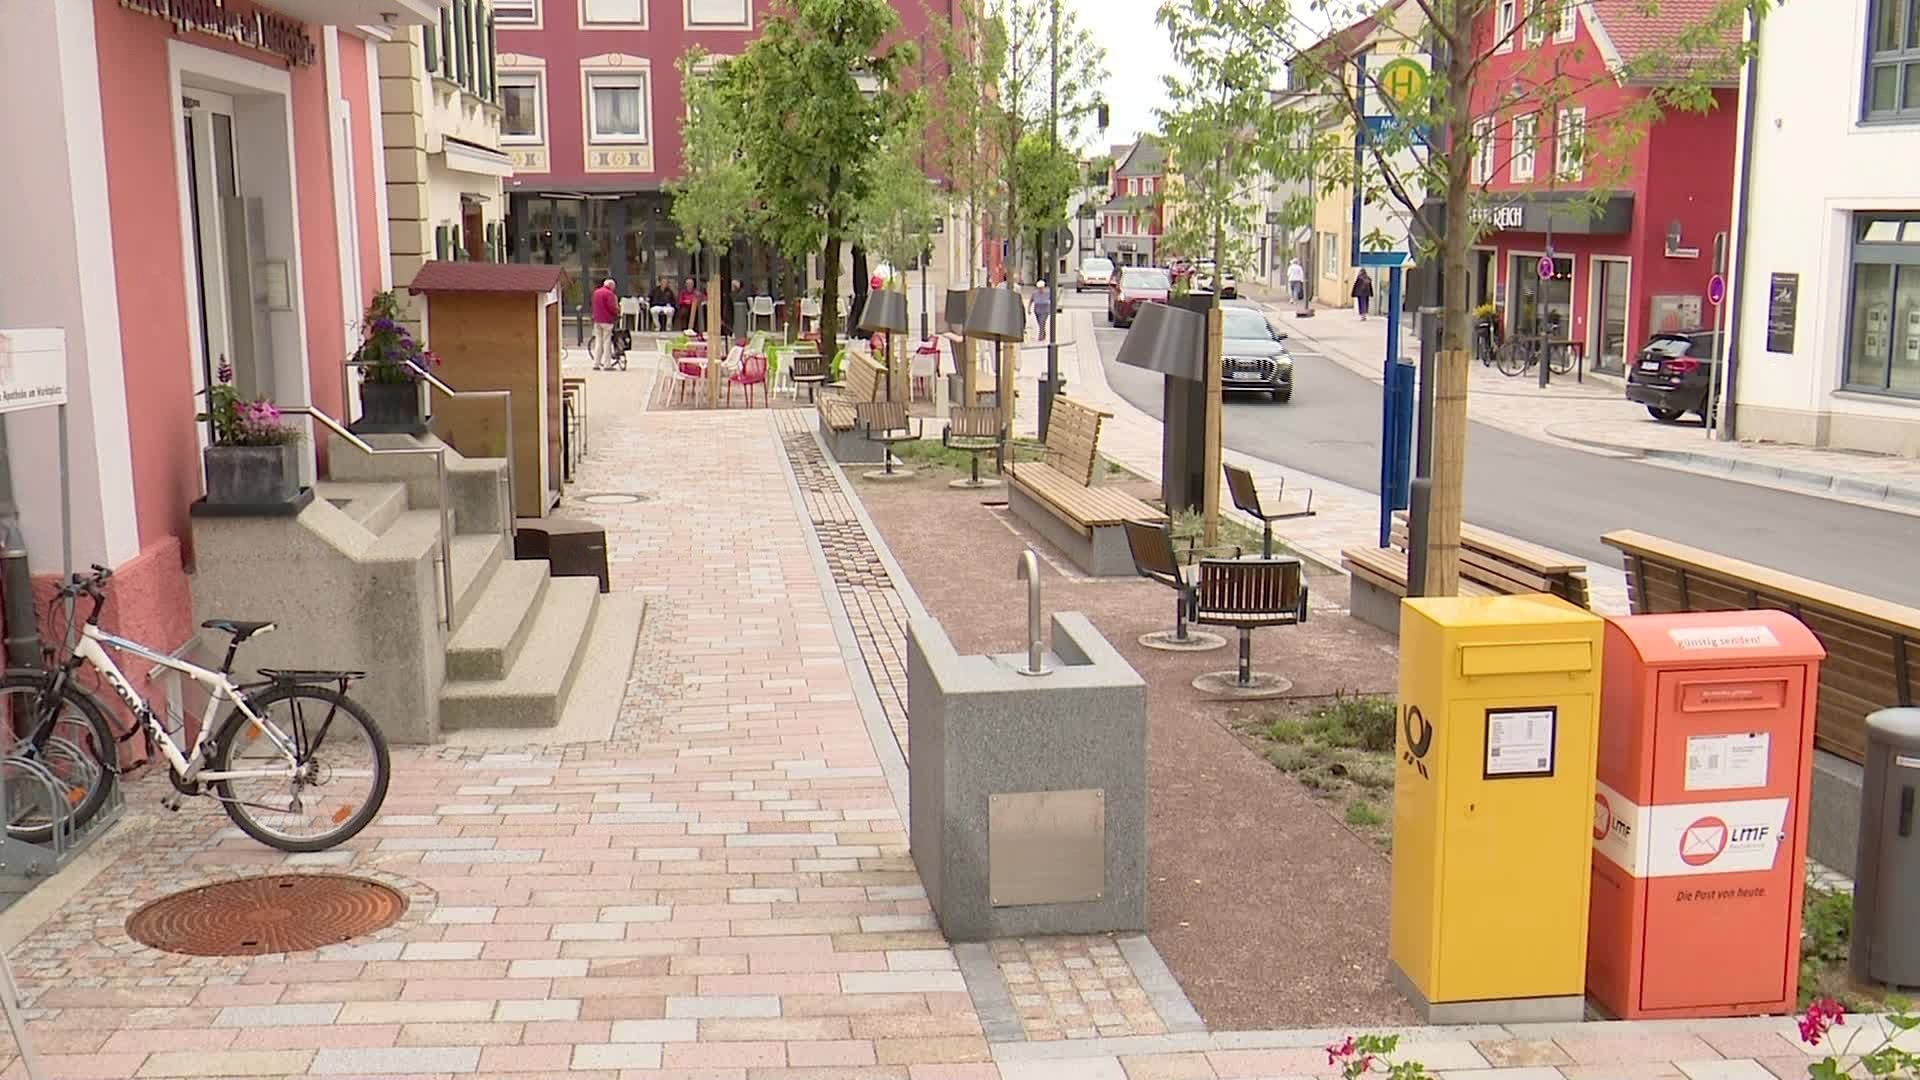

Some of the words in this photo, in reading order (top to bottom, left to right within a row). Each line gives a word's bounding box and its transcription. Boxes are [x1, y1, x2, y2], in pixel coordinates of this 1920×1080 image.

[1391, 70, 1413, 98] H
[104, 670, 168, 752] CONAY
[1676, 890, 1693, 902] Die
[1694, 889, 1716, 902] Post
[1717, 890, 1735, 900] von
